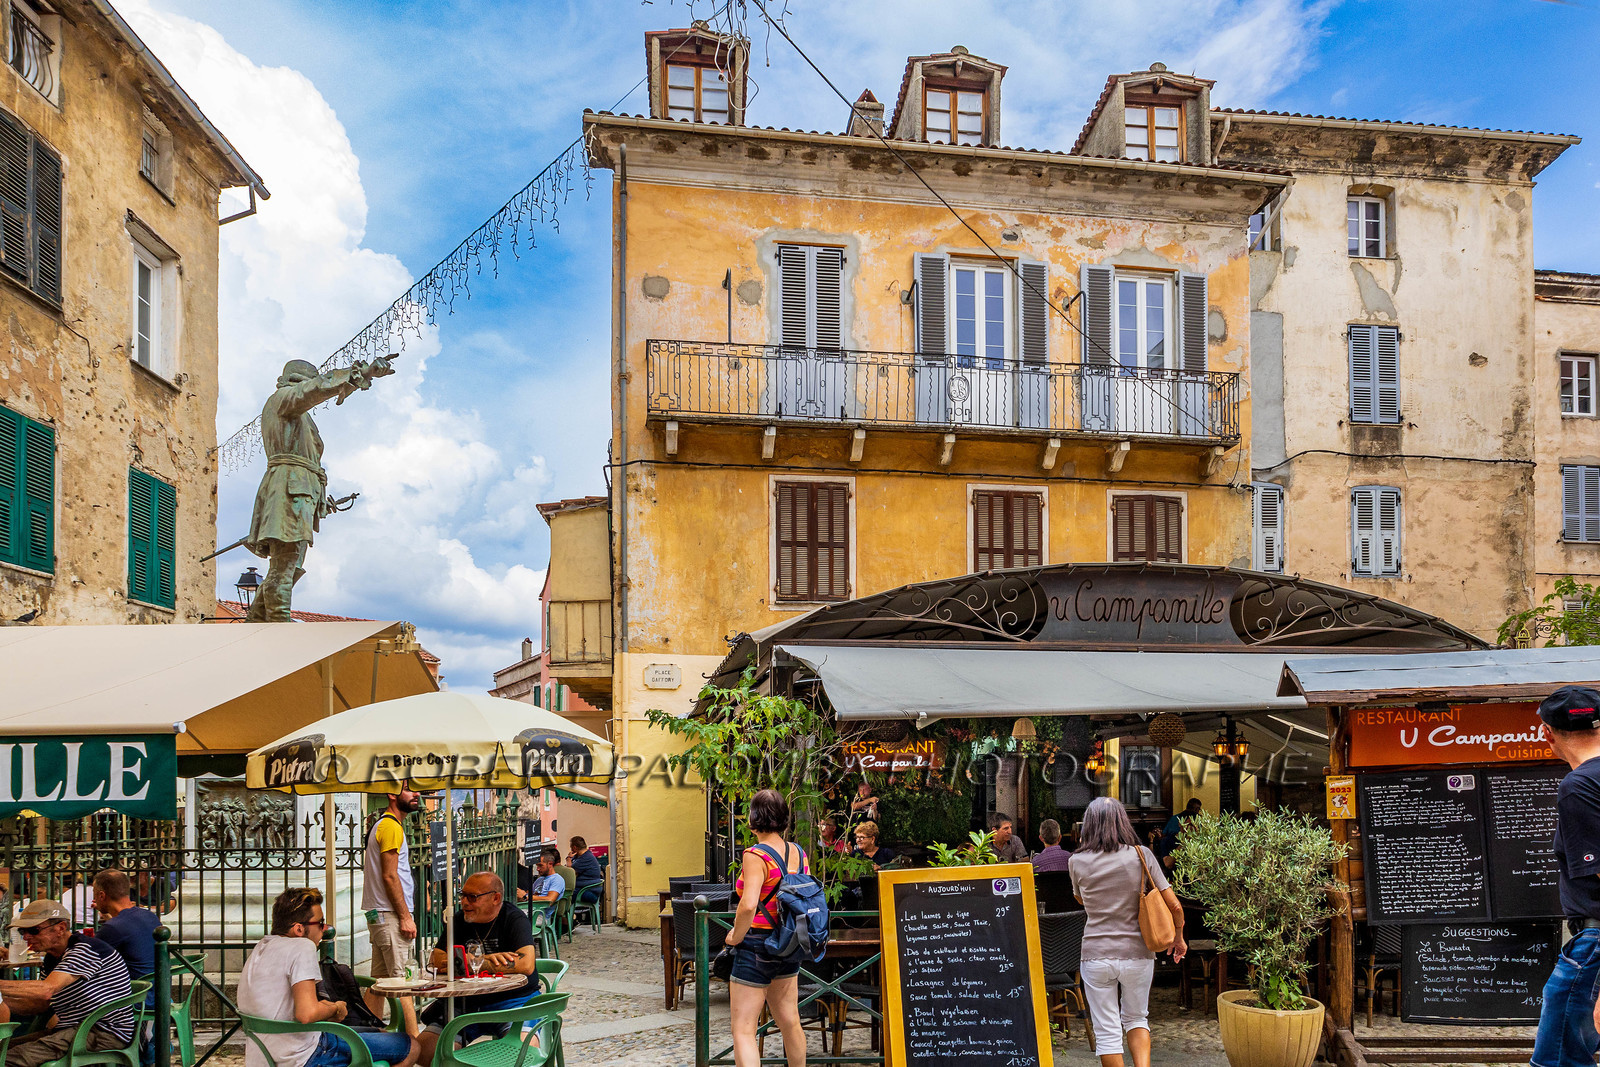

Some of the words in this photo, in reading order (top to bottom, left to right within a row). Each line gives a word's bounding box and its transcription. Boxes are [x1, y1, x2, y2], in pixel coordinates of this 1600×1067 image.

[1074, 578, 1225, 640] Campanile
[1356, 708, 1463, 726] RESTAURANT
[1400, 727, 1419, 748] U
[1428, 724, 1547, 751] Campanil
[376, 756, 389, 768] La
[393, 754, 422, 768] Bière
[427, 752, 457, 766] Corse
[526, 748, 586, 775] Pietra
[1496, 745, 1553, 760] Cuisine
[269, 757, 314, 785] Pietra
